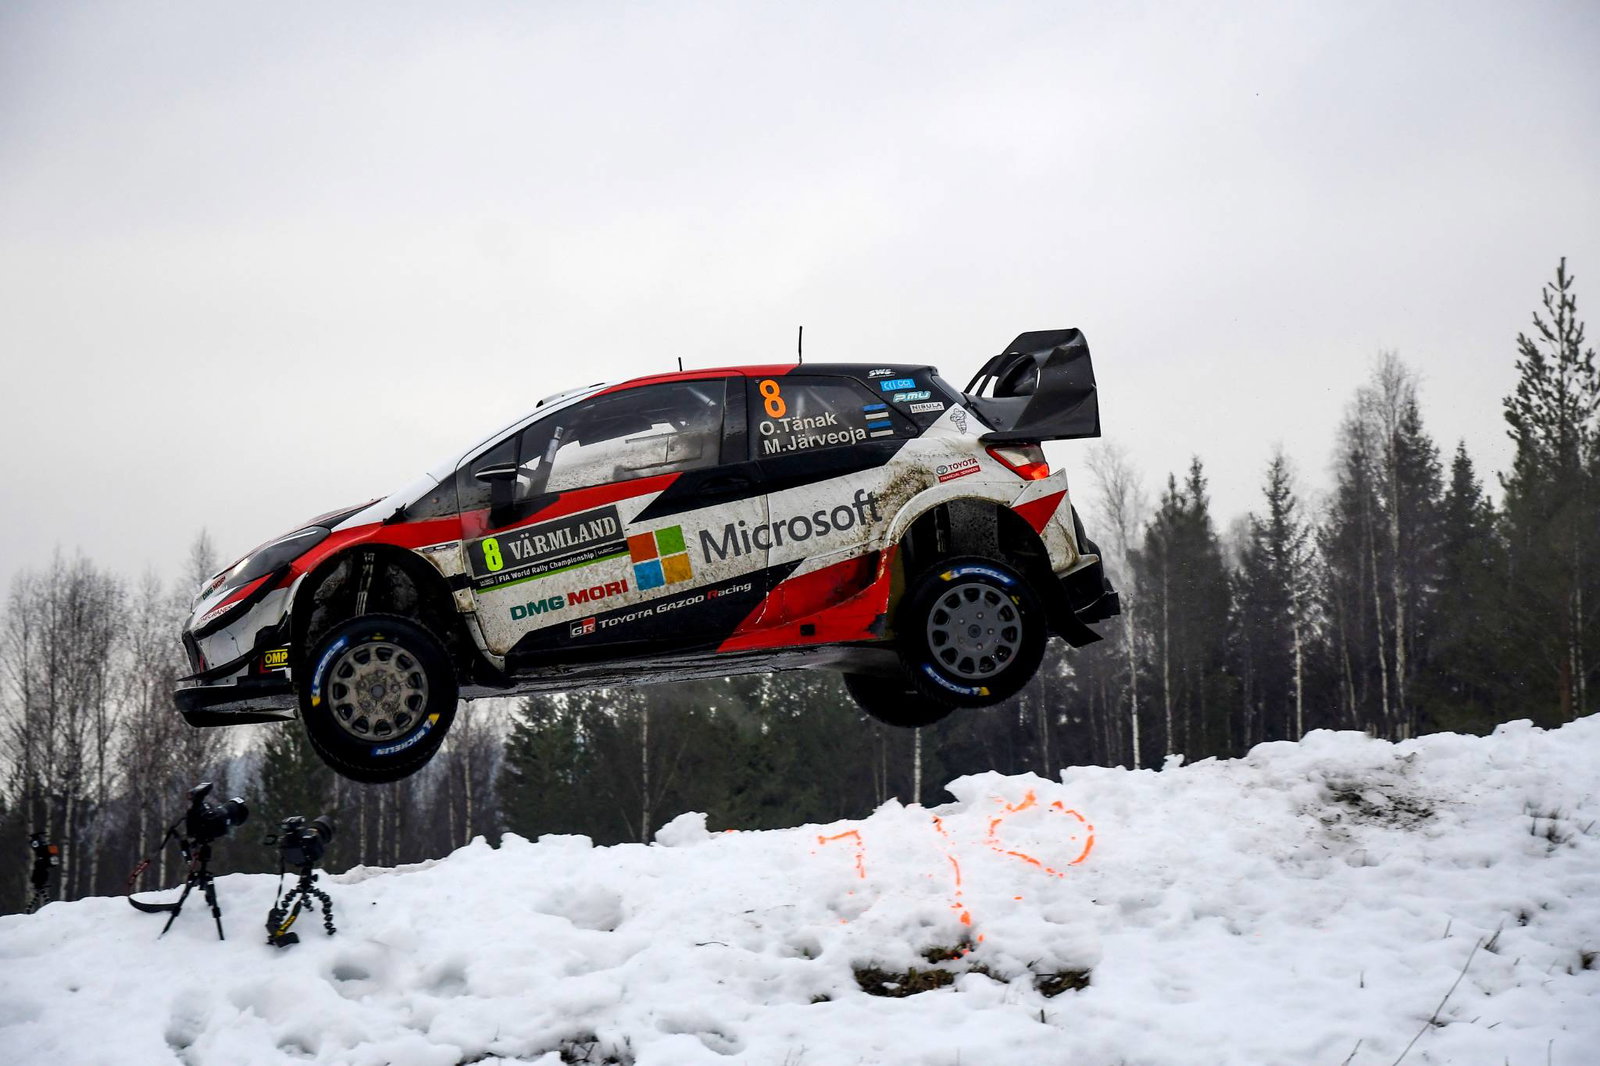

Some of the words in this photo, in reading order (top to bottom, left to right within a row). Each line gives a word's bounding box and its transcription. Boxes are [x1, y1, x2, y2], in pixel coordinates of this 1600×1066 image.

[760, 379, 787, 418] 8
[760, 412, 838, 436] O.Tänak
[764, 426, 867, 455] M.Järveoja
[948, 457, 978, 470] TOYOTA
[508, 516, 617, 560] VÄRMLAND
[699, 489, 882, 563] Microsoft
[481, 537, 504, 572] 8
[498, 574, 510, 583] FIA
[511, 568, 531, 579] World
[531, 564, 548, 575] Rally
[549, 551, 594, 569] Championship
[510, 595, 565, 621] DMG
[567, 579, 629, 605] MORI
[599, 608, 653, 629] TOYOTA
[656, 594, 704, 613] GAZOO
[707, 582, 752, 600] Racing
[571, 622, 595, 637] GR
[265, 651, 288, 664] OMP
